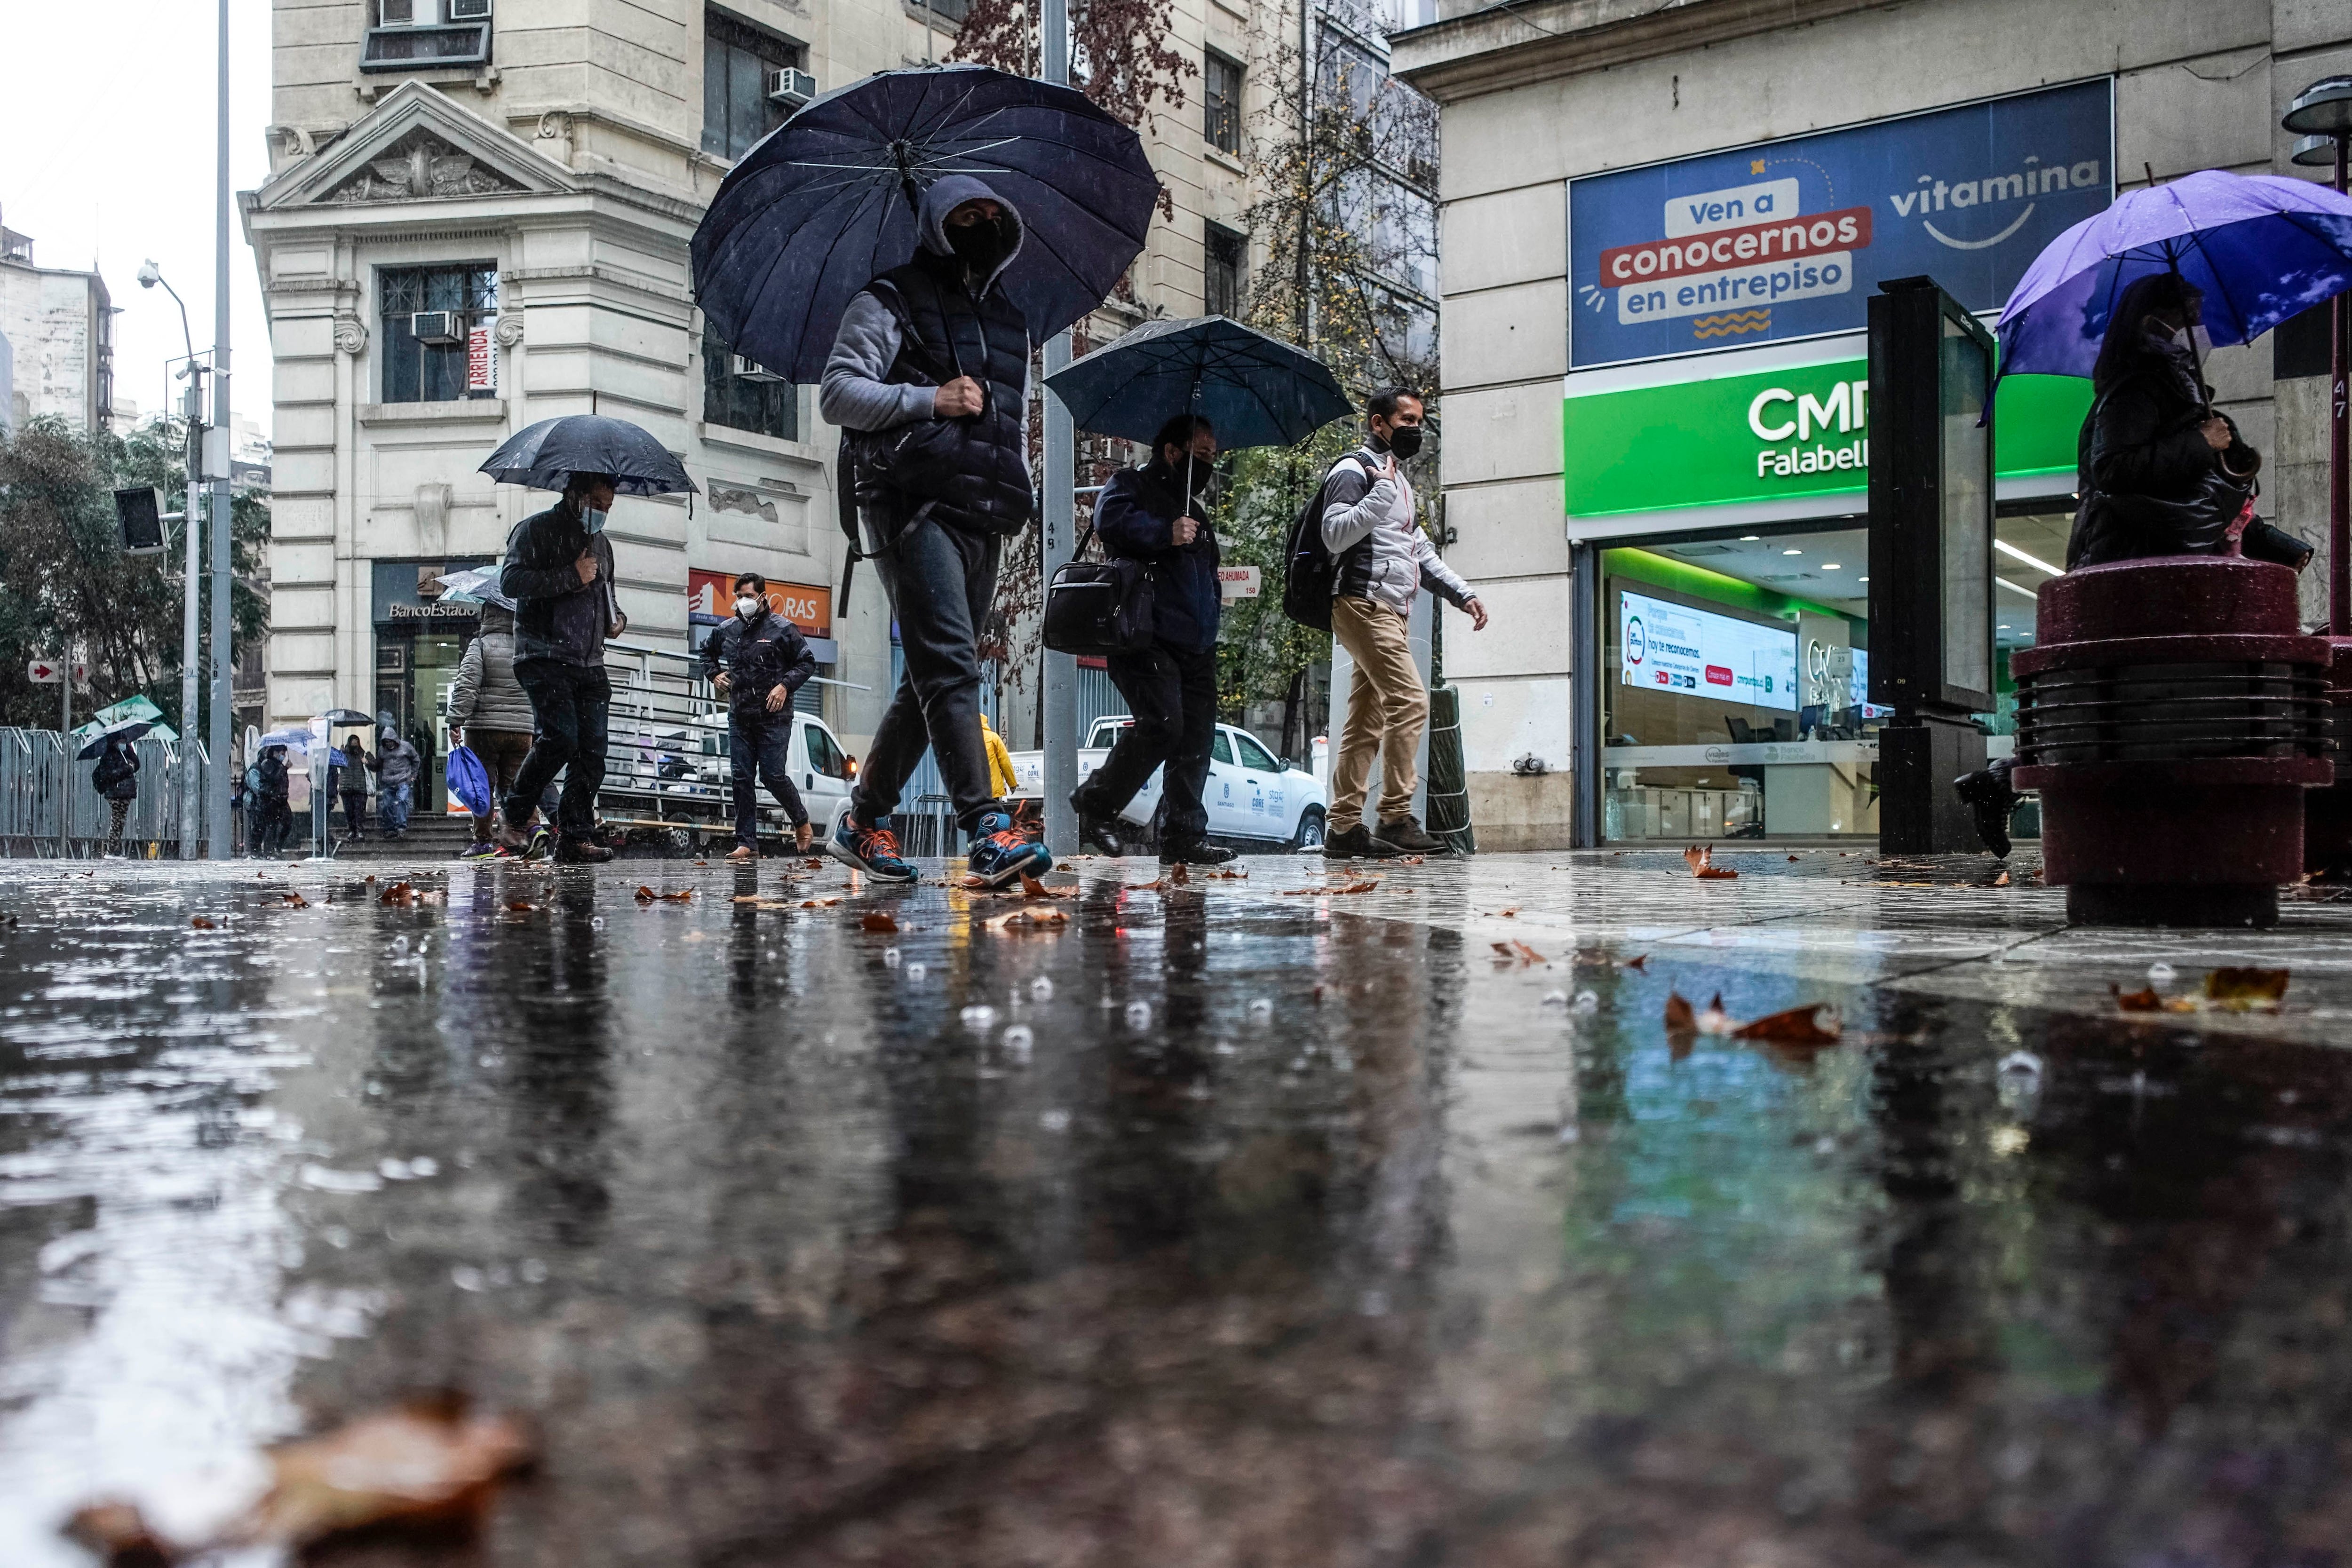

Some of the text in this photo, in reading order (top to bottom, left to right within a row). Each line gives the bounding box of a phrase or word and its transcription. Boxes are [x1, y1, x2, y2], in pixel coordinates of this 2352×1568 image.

[1890, 156, 2099, 217] vitamina
[1690, 194, 1773, 224] Ven a
[1612, 216, 1859, 279] conocernos
[1627, 262, 1842, 314] en entrepiso
[469, 330, 487, 386] ARRIENDA
[1758, 438, 1868, 478] Falabell
[1225, 570, 1249, 581] AHUMADA
[1648, 637, 1658, 654] hoy
[1659, 640, 1664, 651] te
[1252, 798, 1264, 808] CORE
